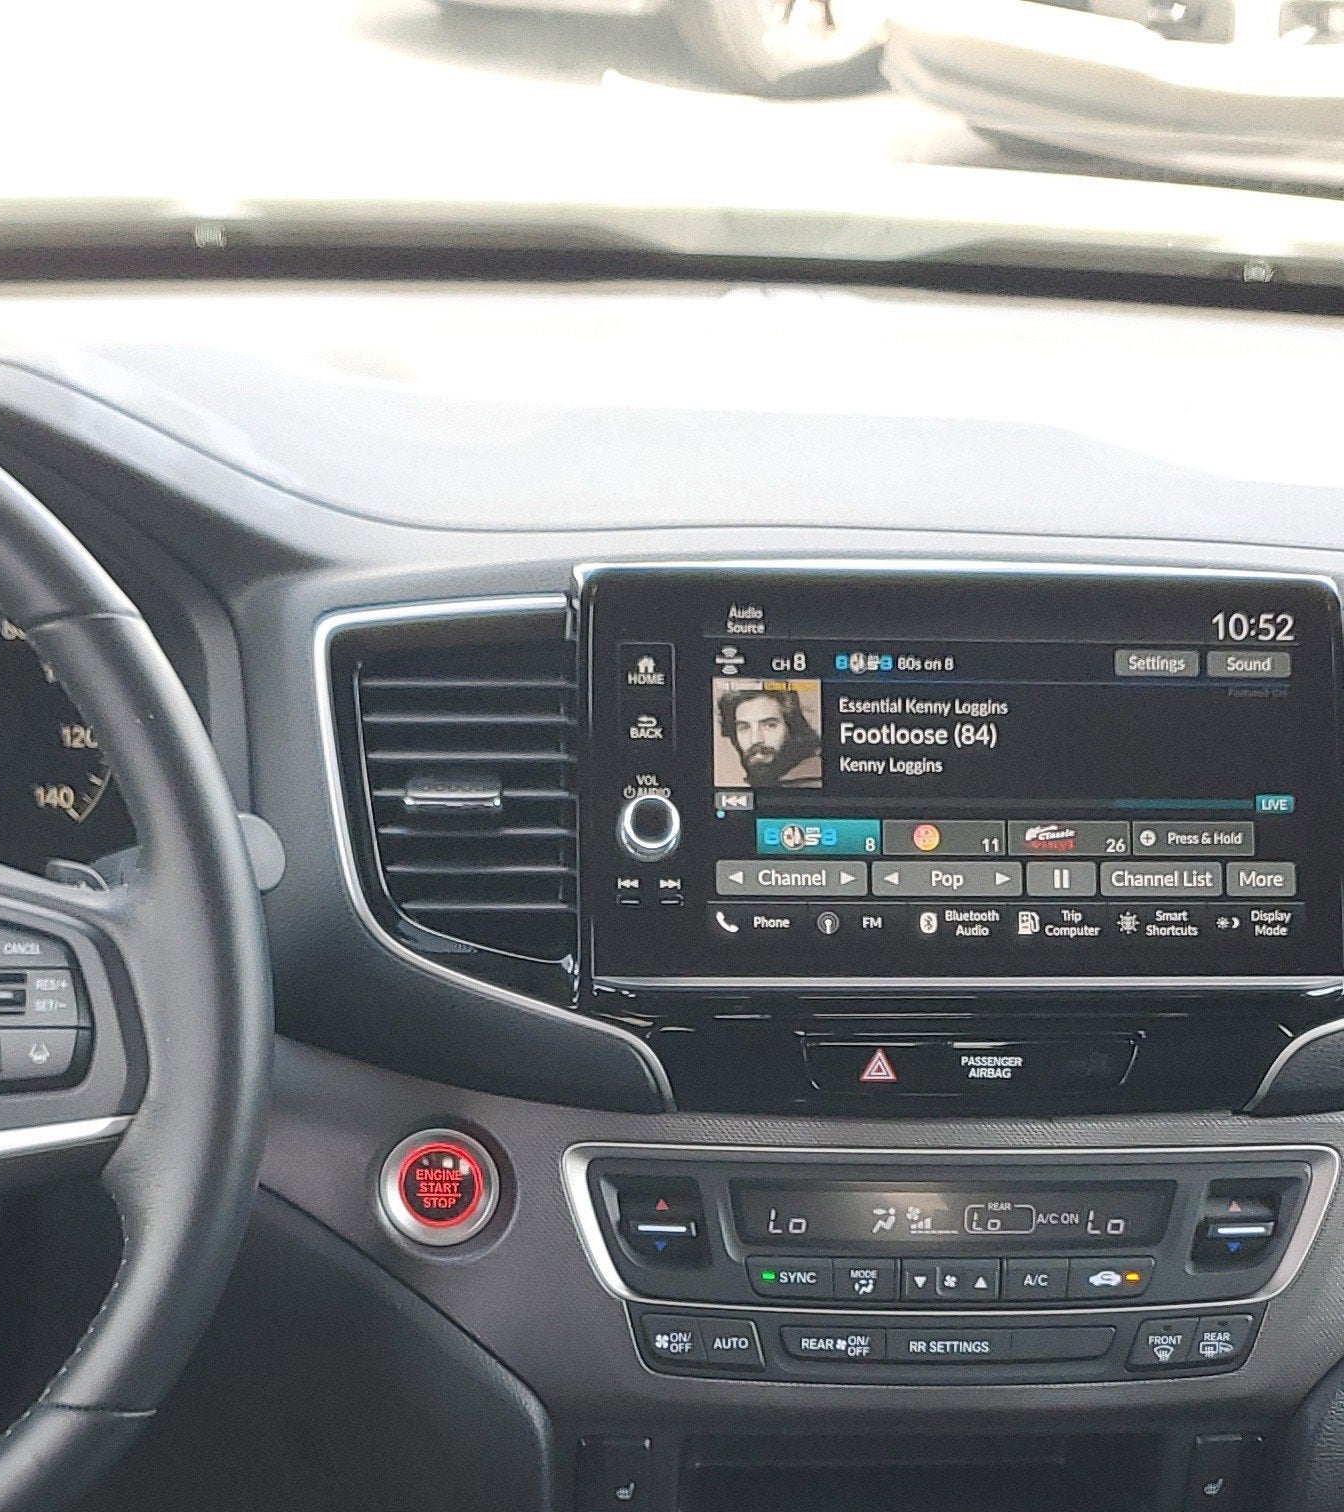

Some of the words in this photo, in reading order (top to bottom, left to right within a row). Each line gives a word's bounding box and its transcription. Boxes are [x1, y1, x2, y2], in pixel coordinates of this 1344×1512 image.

[729, 604, 763, 620] Audio
[727, 621, 765, 634] Source
[1212, 613, 1295, 642] 10:52
[772, 658, 791, 671] CH
[793, 654, 806, 671] 8
[897, 657, 921, 671] 80s
[924, 660, 942, 671] on
[944, 657, 954, 671] 8
[1128, 655, 1186, 673] Settings
[1226, 657, 1271, 671] Sound
[628, 673, 665, 685] HOME
[839, 698, 902, 714] Essential
[906, 699, 950, 716] Kenny
[955, 699, 1008, 716] Loggins
[630, 728, 663, 740] BACK
[840, 723, 948, 745] Footloose
[954, 723, 998, 748] (84)
[840, 757, 885, 774] Kenny
[889, 757, 943, 774] Loggins
[636, 774, 659, 786] VOL
[34, 784, 74, 809] 140
[636, 787, 671, 798] AUDIO
[1261, 799, 1288, 811] LIVE
[865, 838, 876, 851] 8
[1167, 832, 1199, 845] Press
[1201, 833, 1211, 845] &
[1213, 832, 1242, 844] Hold
[982, 838, 1000, 853] 11
[1105, 838, 1126, 853] 26
[758, 869, 827, 887] Channel
[931, 870, 964, 890] Pop
[1111, 870, 1179, 887] Channel
[1183, 871, 1213, 887] List
[1239, 871, 1284, 887] More
[945, 910, 999, 922] Bluetooth
[1061, 910, 1082, 924] Trip
[1155, 910, 1187, 922] Smart
[1251, 910, 1292, 924] Display
[753, 916, 790, 929] Phone
[862, 917, 882, 928] FM
[955, 924, 990, 936] Audio
[1045, 924, 1100, 938] Computer
[1145, 924, 1198, 937] Shortcuts
[1255, 925, 1288, 937] Mode
[961, 1056, 1022, 1067] PASSENGER
[968, 1067, 1012, 1079] AIRBAG
[416, 1169, 463, 1181] ENGINE
[419, 1183, 460, 1193] START
[423, 1197, 456, 1208] STOP
[988, 1202, 1011, 1211] REAR
[1036, 1213, 1059, 1225] A/C
[1060, 1213, 1079, 1225] ON
[779, 1271, 817, 1284] SYNC
[850, 1269, 878, 1279] MODE
[1024, 1273, 1048, 1287] A/C
[670, 1332, 692, 1343] ON/
[848, 1335, 870, 1346] ON/
[1148, 1335, 1182, 1346] FRONT
[1203, 1332, 1231, 1342] REAR
[670, 1343, 693, 1354] OFF
[713, 1338, 749, 1350] AUTO
[802, 1338, 834, 1350] REAR
[909, 1342, 926, 1353] RR
[929, 1341, 990, 1353] SETTINGS
[848, 1346, 871, 1357] OFF
